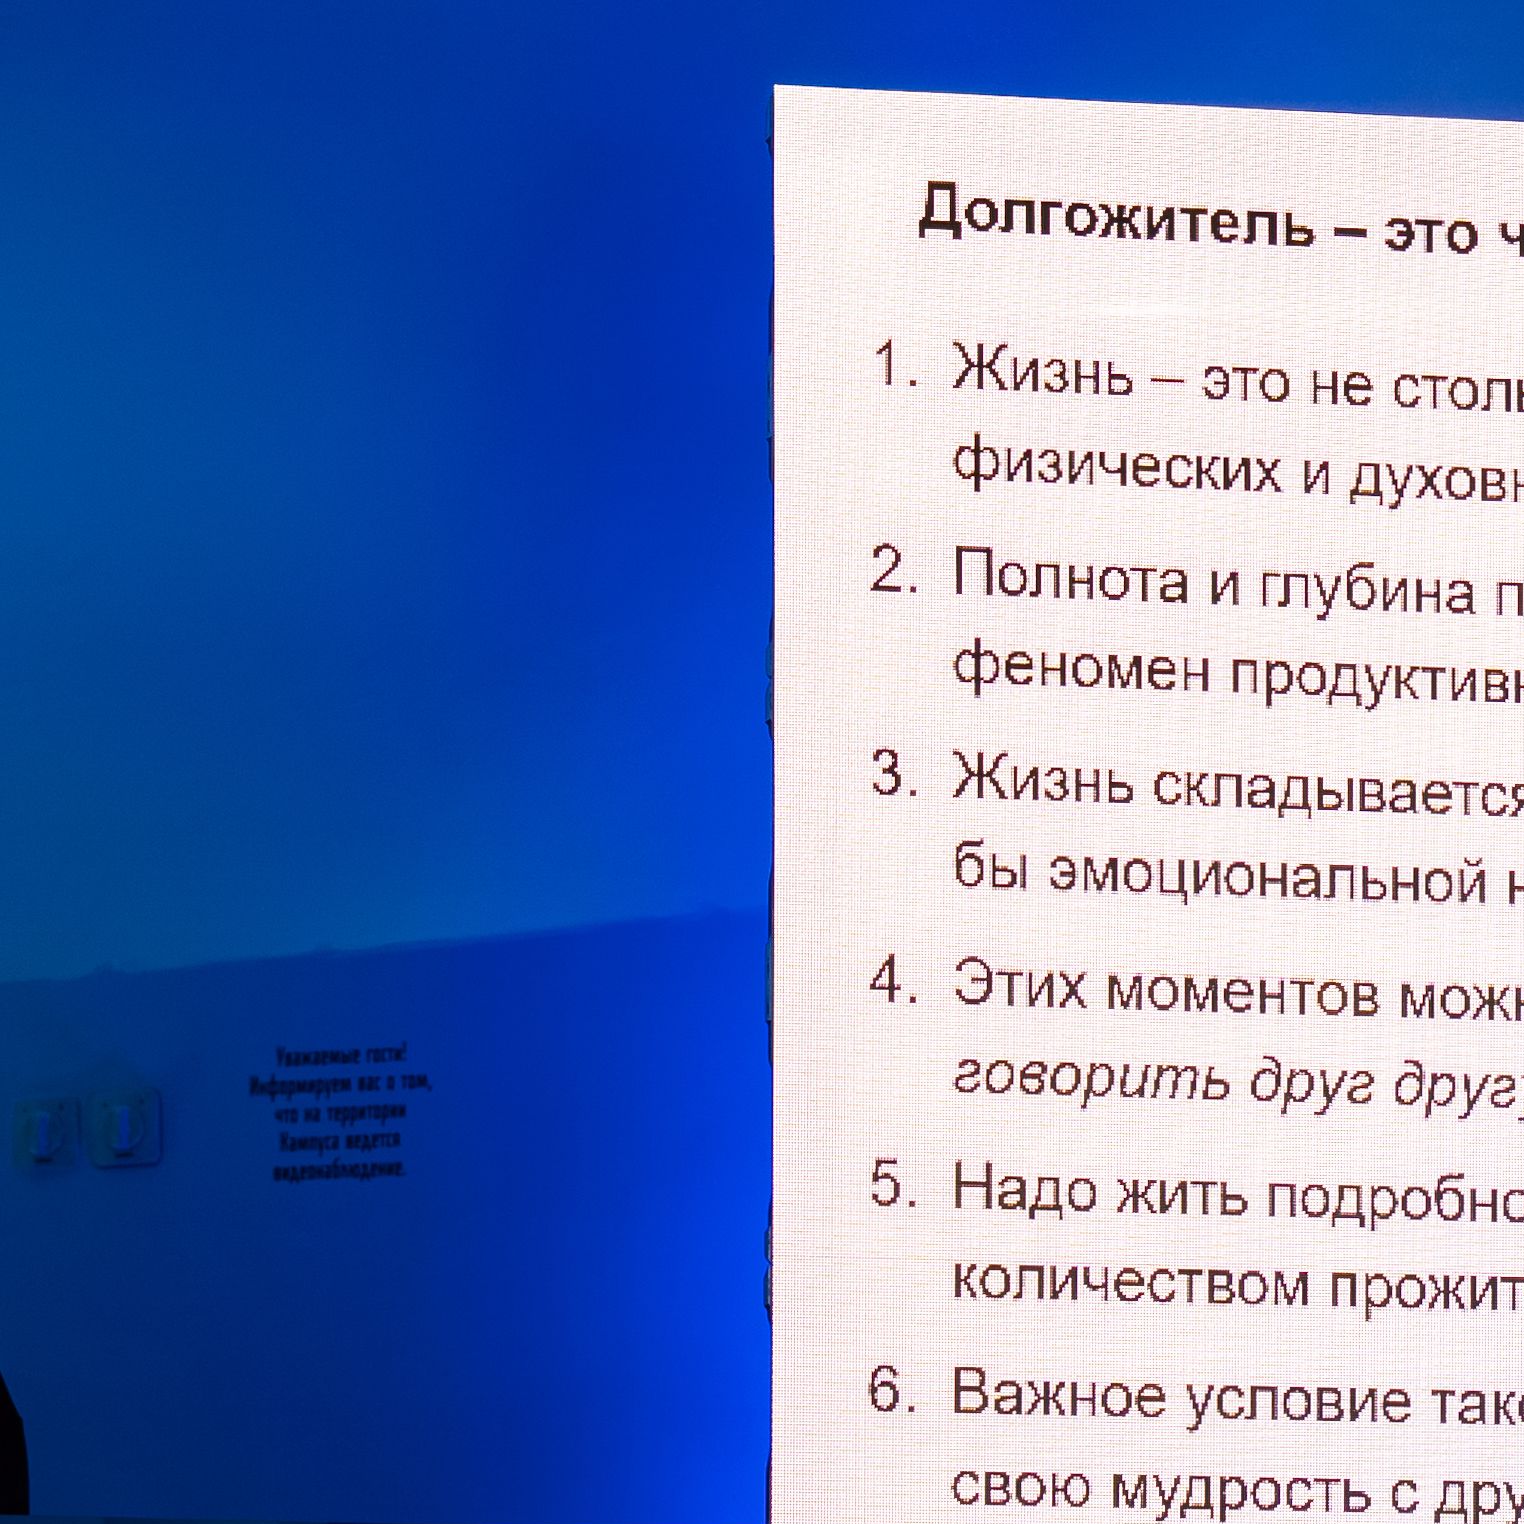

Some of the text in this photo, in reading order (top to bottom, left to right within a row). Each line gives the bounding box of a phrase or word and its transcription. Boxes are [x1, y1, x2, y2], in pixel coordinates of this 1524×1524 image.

[917, 178, 1317, 250] Долгожитель
[1383, 215, 1480, 257] это
[876, 338, 918, 388] 1.
[952, 340, 1135, 398] Жизнь
[1201, 363, 1292, 405] это
[1311, 369, 1375, 408] не
[952, 431, 1284, 495] физических
[1302, 459, 1331, 496] и
[870, 540, 919, 595] 2.
[954, 543, 1190, 606] Полнота
[1208, 569, 1240, 607] и
[1259, 559, 1476, 622] глубина
[951, 636, 1211, 699] феномен
[870, 746, 917, 798] 3.
[951, 748, 1135, 806] Жизнь
[953, 837, 1028, 891] бы
[1048, 853, 1488, 905] эмоциональной
[868, 953, 918, 1006] 4.
[954, 953, 1087, 1010] Этих
[1105, 972, 1382, 1019] моментов
[276, 1040, 407, 1066] Уважаемые гости!
[951, 1056, 1232, 1111] говорить
[1248, 1053, 1376, 1118] друг
[249, 1073, 432, 1101] Информируем вас о том,
[274, 1103, 407, 1128] что на территории
[279, 1131, 401, 1158] Кампуса ведется
[869, 1156, 916, 1209] 5.
[952, 1160, 1098, 1222] Надо
[1115, 1177, 1250, 1218] жить
[952, 1261, 1310, 1308] количеством
[867, 1363, 916, 1415] 6.
[952, 1364, 1168, 1419] Важное
[1185, 1383, 1413, 1434] условие
[950, 1468, 1093, 1509] свою
[1111, 1472, 1373, 1524] мудрость
[1390, 1477, 1420, 1515] с
